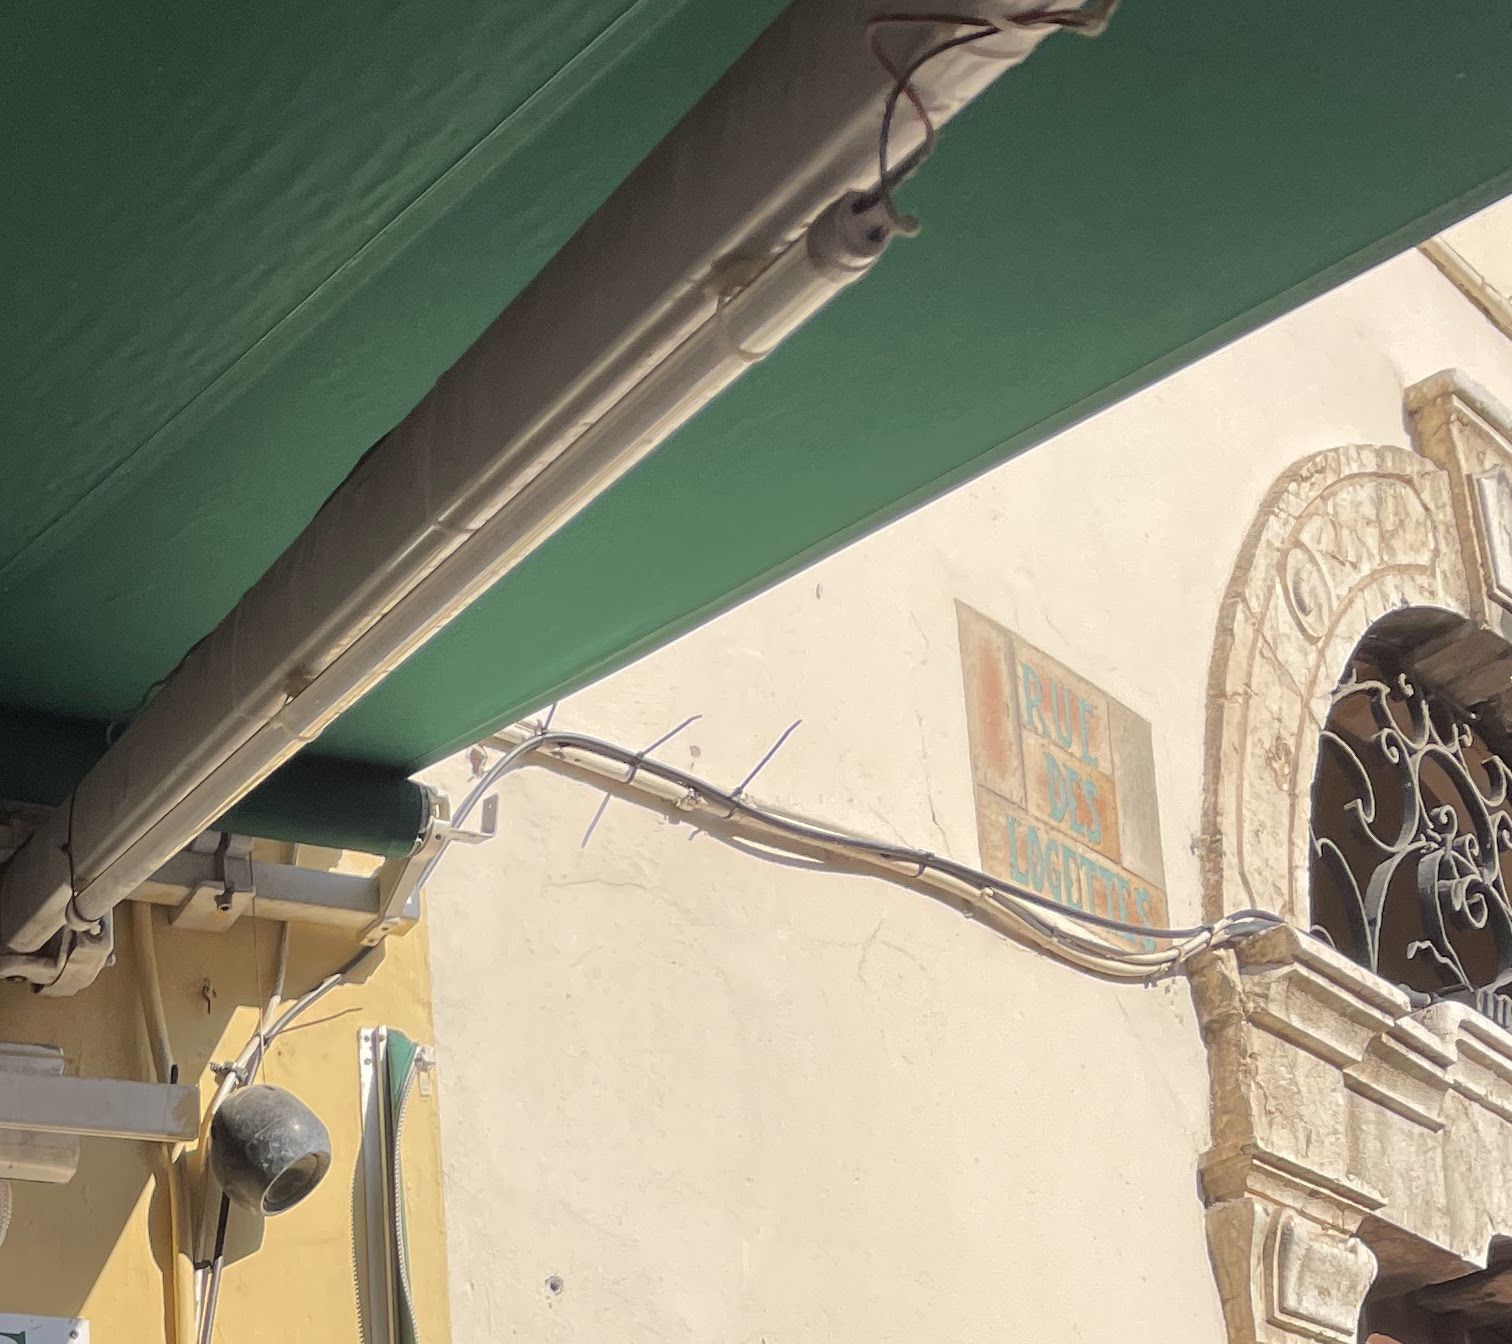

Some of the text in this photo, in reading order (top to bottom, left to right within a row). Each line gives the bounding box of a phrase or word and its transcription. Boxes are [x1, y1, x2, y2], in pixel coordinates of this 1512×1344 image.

[1020, 661, 1098, 766] RUE
[1044, 751, 1102, 845] DES
[1005, 813, 1157, 954] LOGETTES
